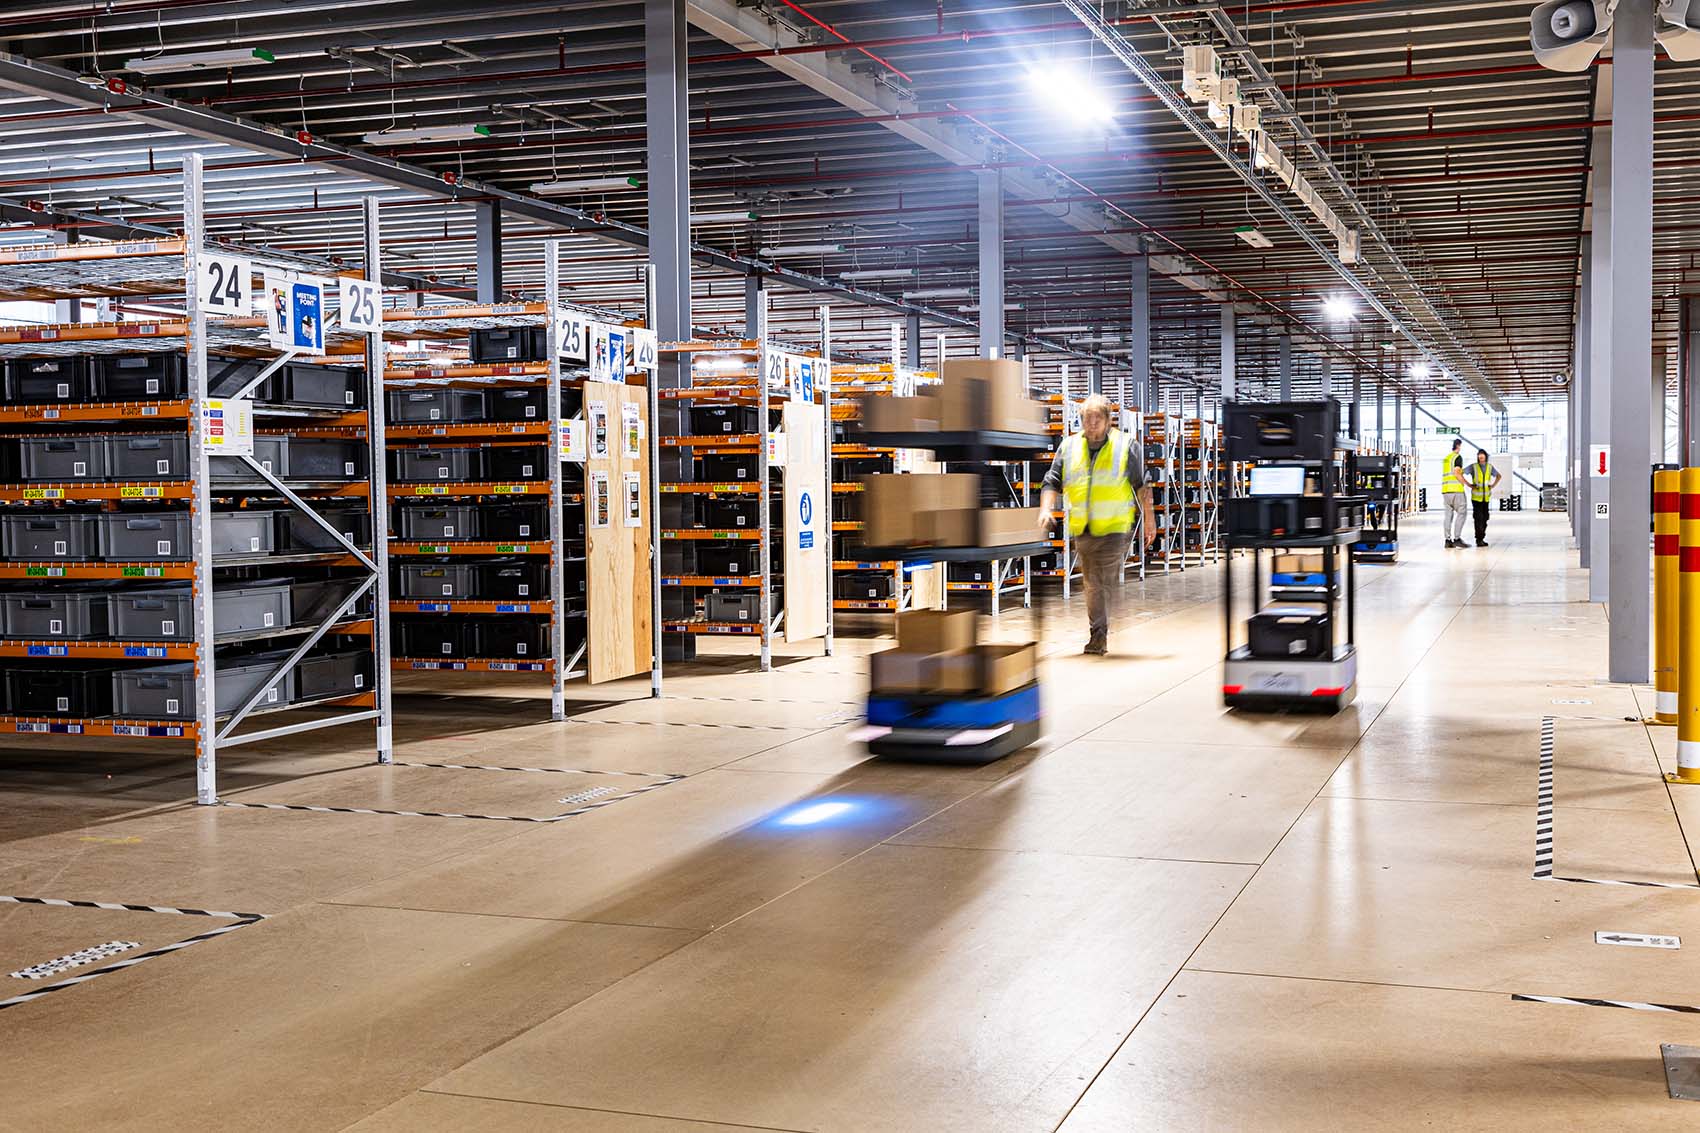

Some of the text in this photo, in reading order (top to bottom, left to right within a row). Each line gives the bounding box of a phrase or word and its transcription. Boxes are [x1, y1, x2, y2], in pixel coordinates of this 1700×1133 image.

[208, 261, 242, 308] 24
[296, 292, 317, 301] MEETING
[299, 298, 315, 306] POINT
[349, 284, 374, 326] 25
[562, 319, 580, 354] 25
[639, 337, 653, 364] 26
[769, 353, 782, 381] 26
[818, 361, 828, 386] 27
[902, 375, 910, 397] 27
